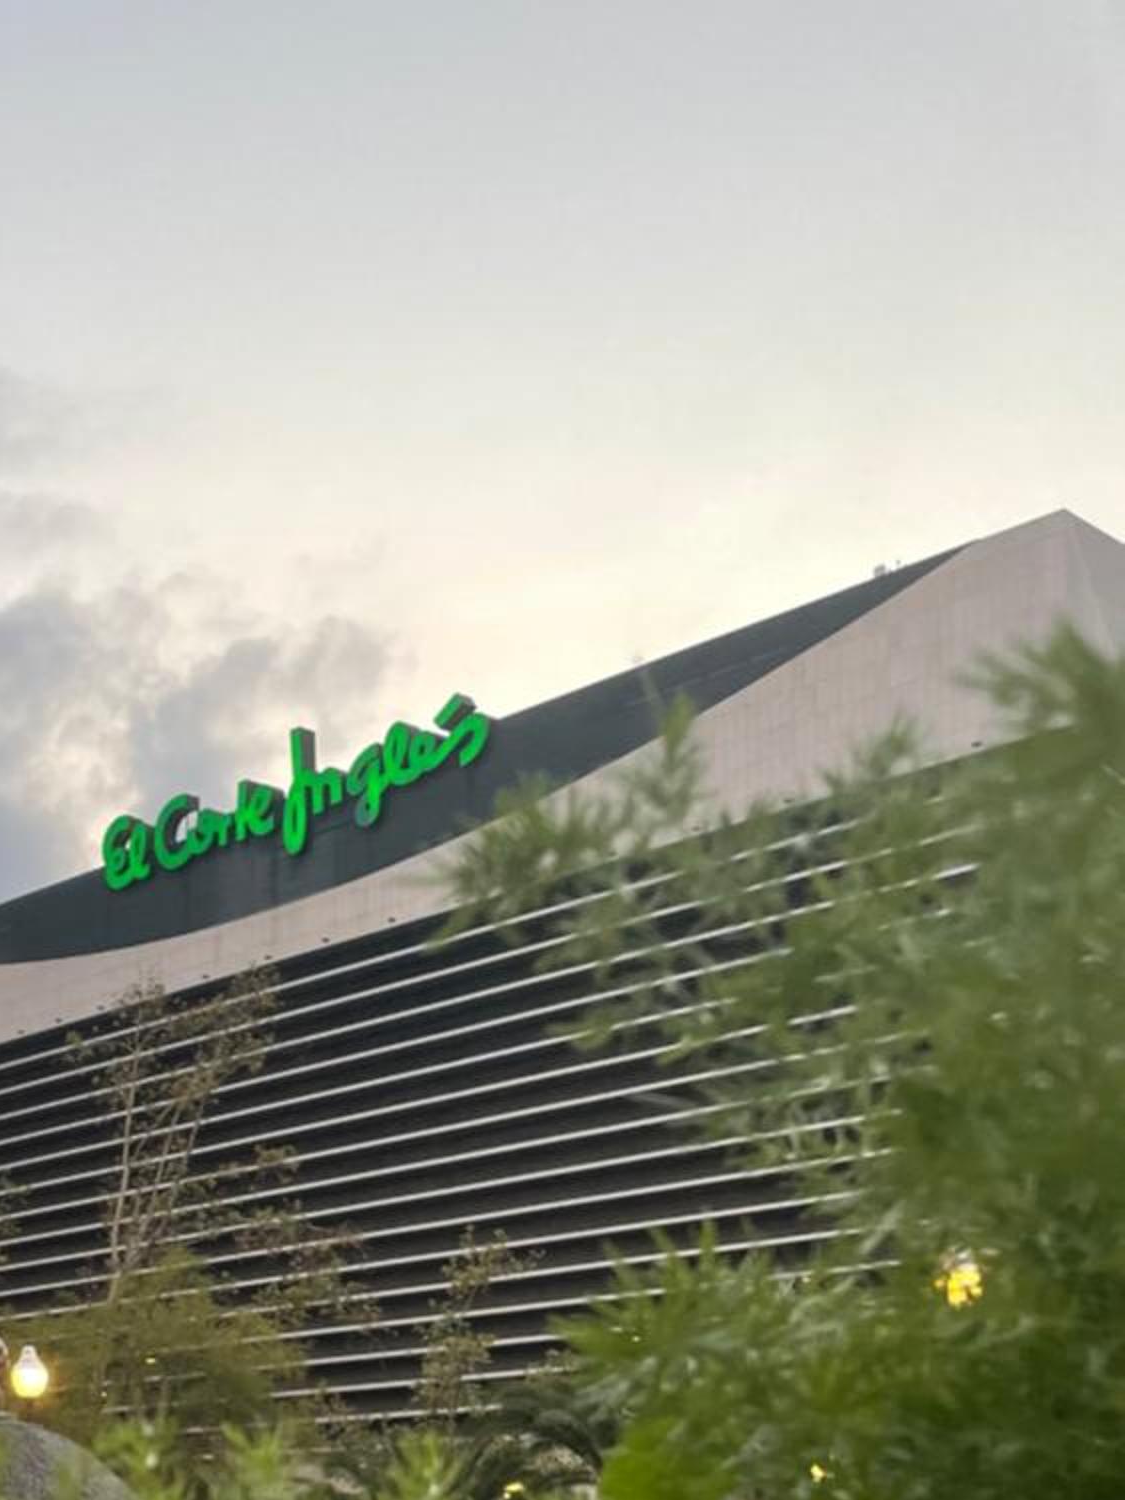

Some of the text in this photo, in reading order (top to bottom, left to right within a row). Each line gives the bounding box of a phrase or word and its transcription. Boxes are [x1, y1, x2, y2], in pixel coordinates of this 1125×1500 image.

[103, 693, 490, 891] El Corte Inglés
